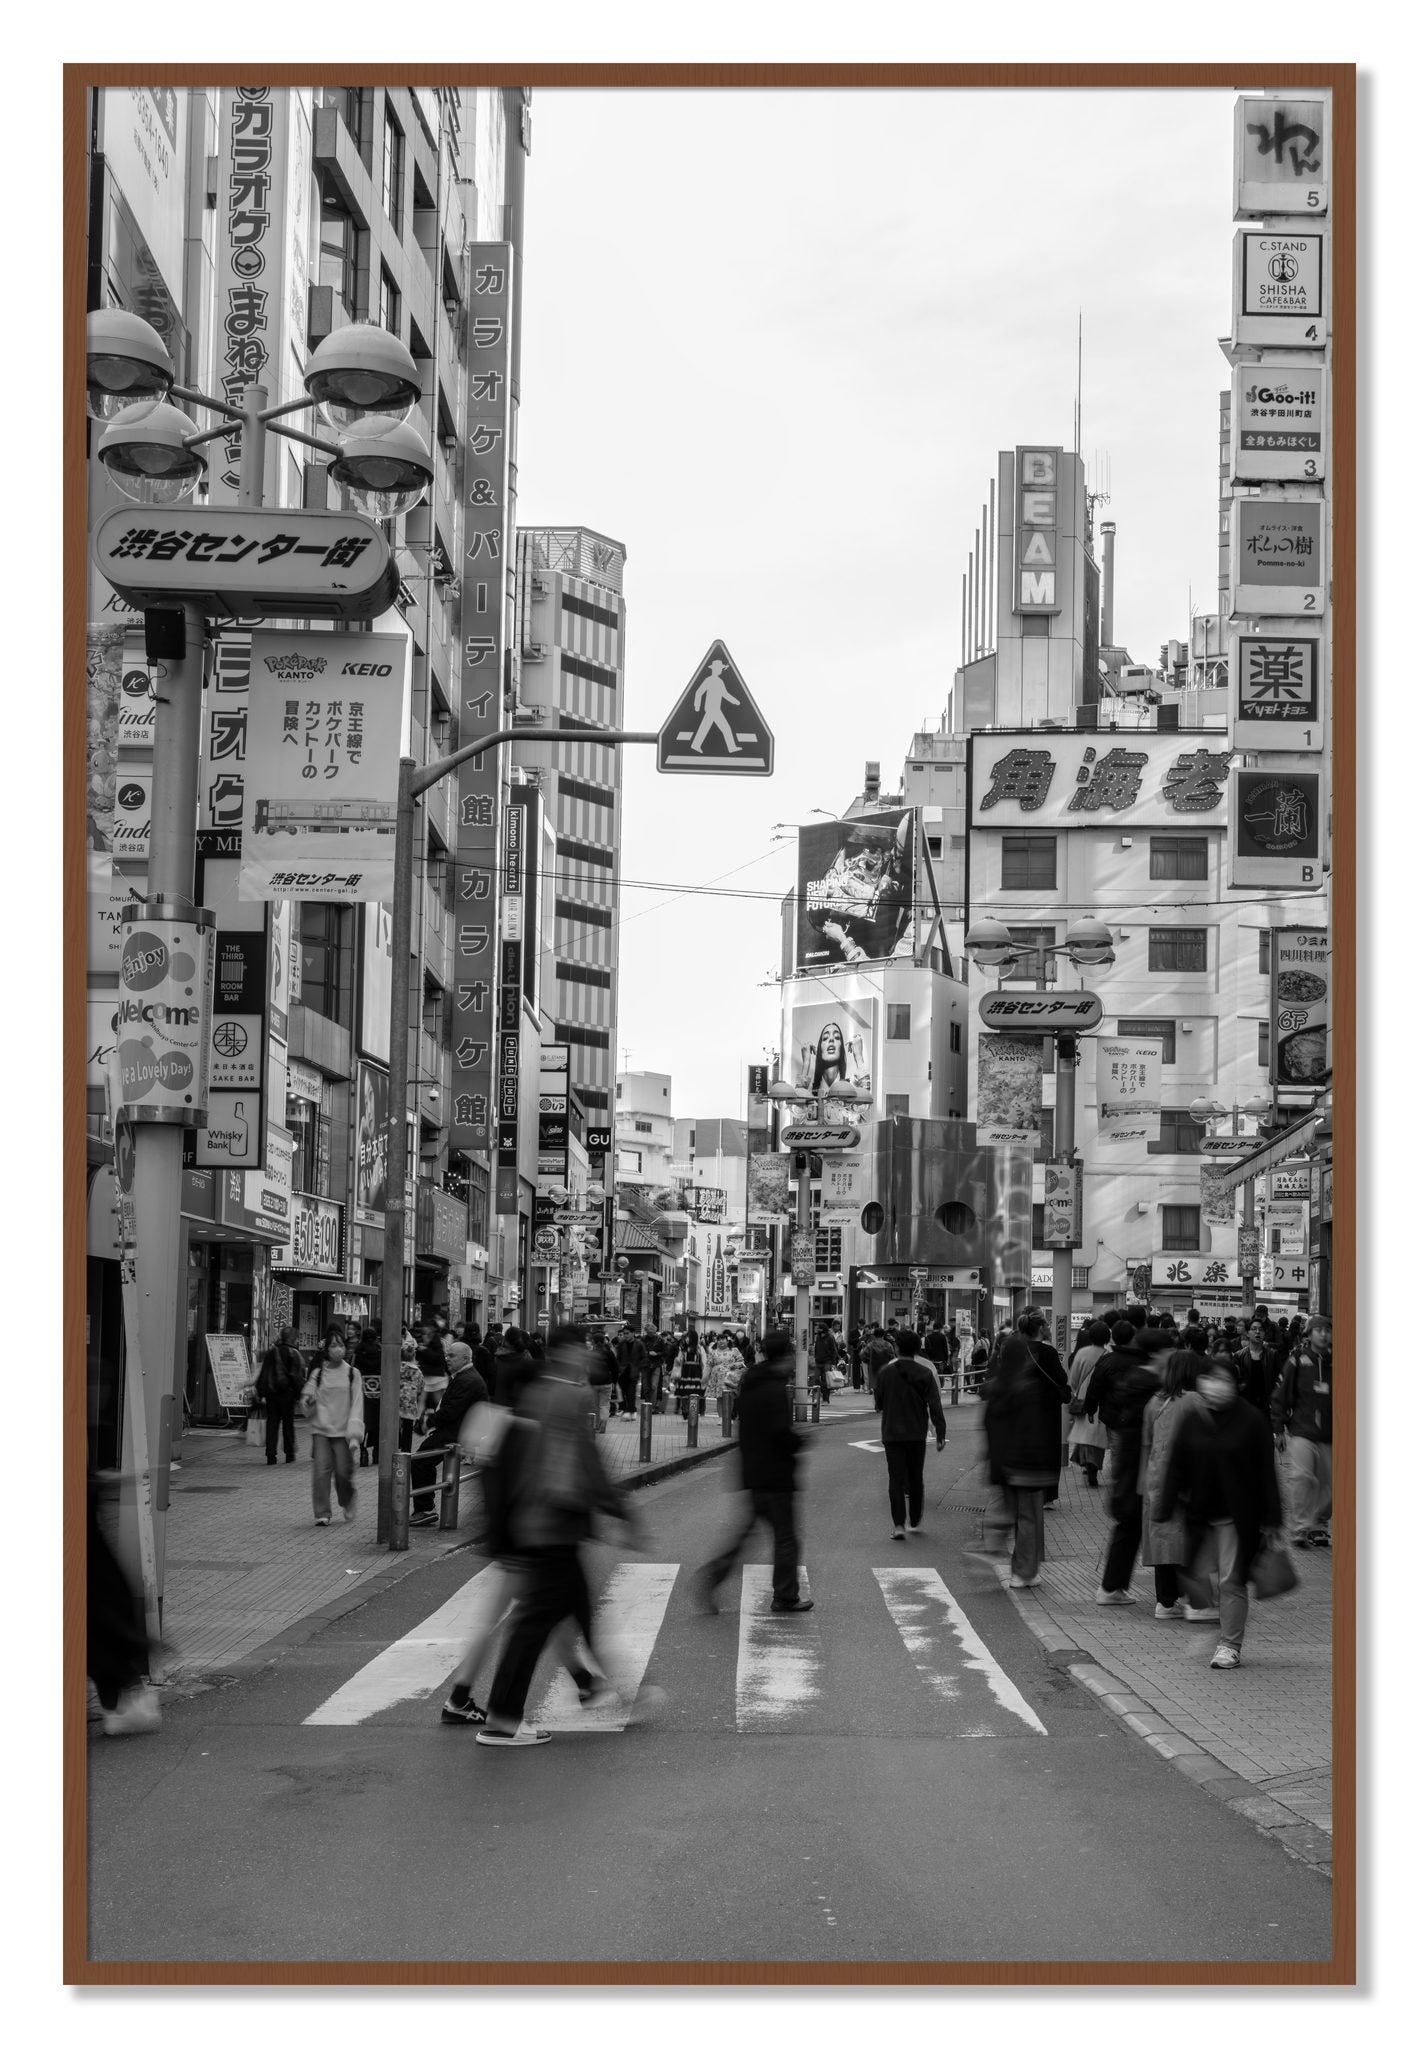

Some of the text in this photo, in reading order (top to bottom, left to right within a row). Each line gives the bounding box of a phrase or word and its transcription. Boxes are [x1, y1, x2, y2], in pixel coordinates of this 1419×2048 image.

[1247, 111, 1320, 176] わん
[229, 101, 273, 248] カラオケ
[1307, 191, 1319, 207] 5
[1260, 241, 1307, 251] C.STAND
[1260, 284, 1306, 295] SHISHA
[1305, 325, 1318, 341] 4
[1258, 388, 1315, 405] Goo-it!
[1251, 408, 1312, 418] 渋谷宇田川町店
[1246, 435, 1317, 447] 全身もみほぐし
[1304, 459, 1317, 477] 3
[1021, 452, 1056, 604] BEAM
[109, 528, 373, 568] 渋谷センター街
[1246, 534, 1314, 555] ポムの樹
[1257, 559, 1305, 568] Pomme-no-ki
[1304, 594, 1315, 610] 2
[278, 671, 315, 680] KANTO
[341, 662, 393, 677] KEIO
[1250, 645, 1303, 699] 薬
[1244, 703, 1309, 718] マツモトキヨシ
[282, 701, 300, 746] 冒険へ
[123, 729, 150, 740] 渋谷店
[302, 700, 321, 779] カントーの
[323, 700, 342, 780] ポケパーク
[346, 701, 364, 765] 京王線で
[1303, 730, 1312, 746] 1
[979, 748, 1230, 811] 角海老
[1244, 788, 1308, 840] 一蘭
[119, 843, 146, 854] 渋谷店
[509, 810, 518, 890] kimono hearts
[269, 872, 363, 887] 渋谷センター街
[1302, 865, 1314, 882] B
[273, 886, 358, 895] http://www.center-gai.jp
[807, 880, 848, 892] SHAPING
[221, 952, 244, 960] THIRD
[225, 945, 240, 953] THE
[121, 946, 164, 982] Enjoy
[118, 998, 198, 1025] Welcome
[987, 1000, 1095, 1016] 渋谷センター街
[1278, 1010, 1309, 1031] 6F
[136, 1058, 167, 1078] Lovely
[169, 1060, 190, 1076] Day!
[207, 1140, 229, 1149] Bank
[208, 1130, 243, 1143] Whisky
[589, 1134, 610, 1145] GU
[182, 1152, 193, 1163] 1F
[300, 1210, 314, 1263] 50
[320, 1214, 336, 1266] 190
[714, 1259, 724, 1303] BEER
[711, 1305, 725, 1313] HALL
